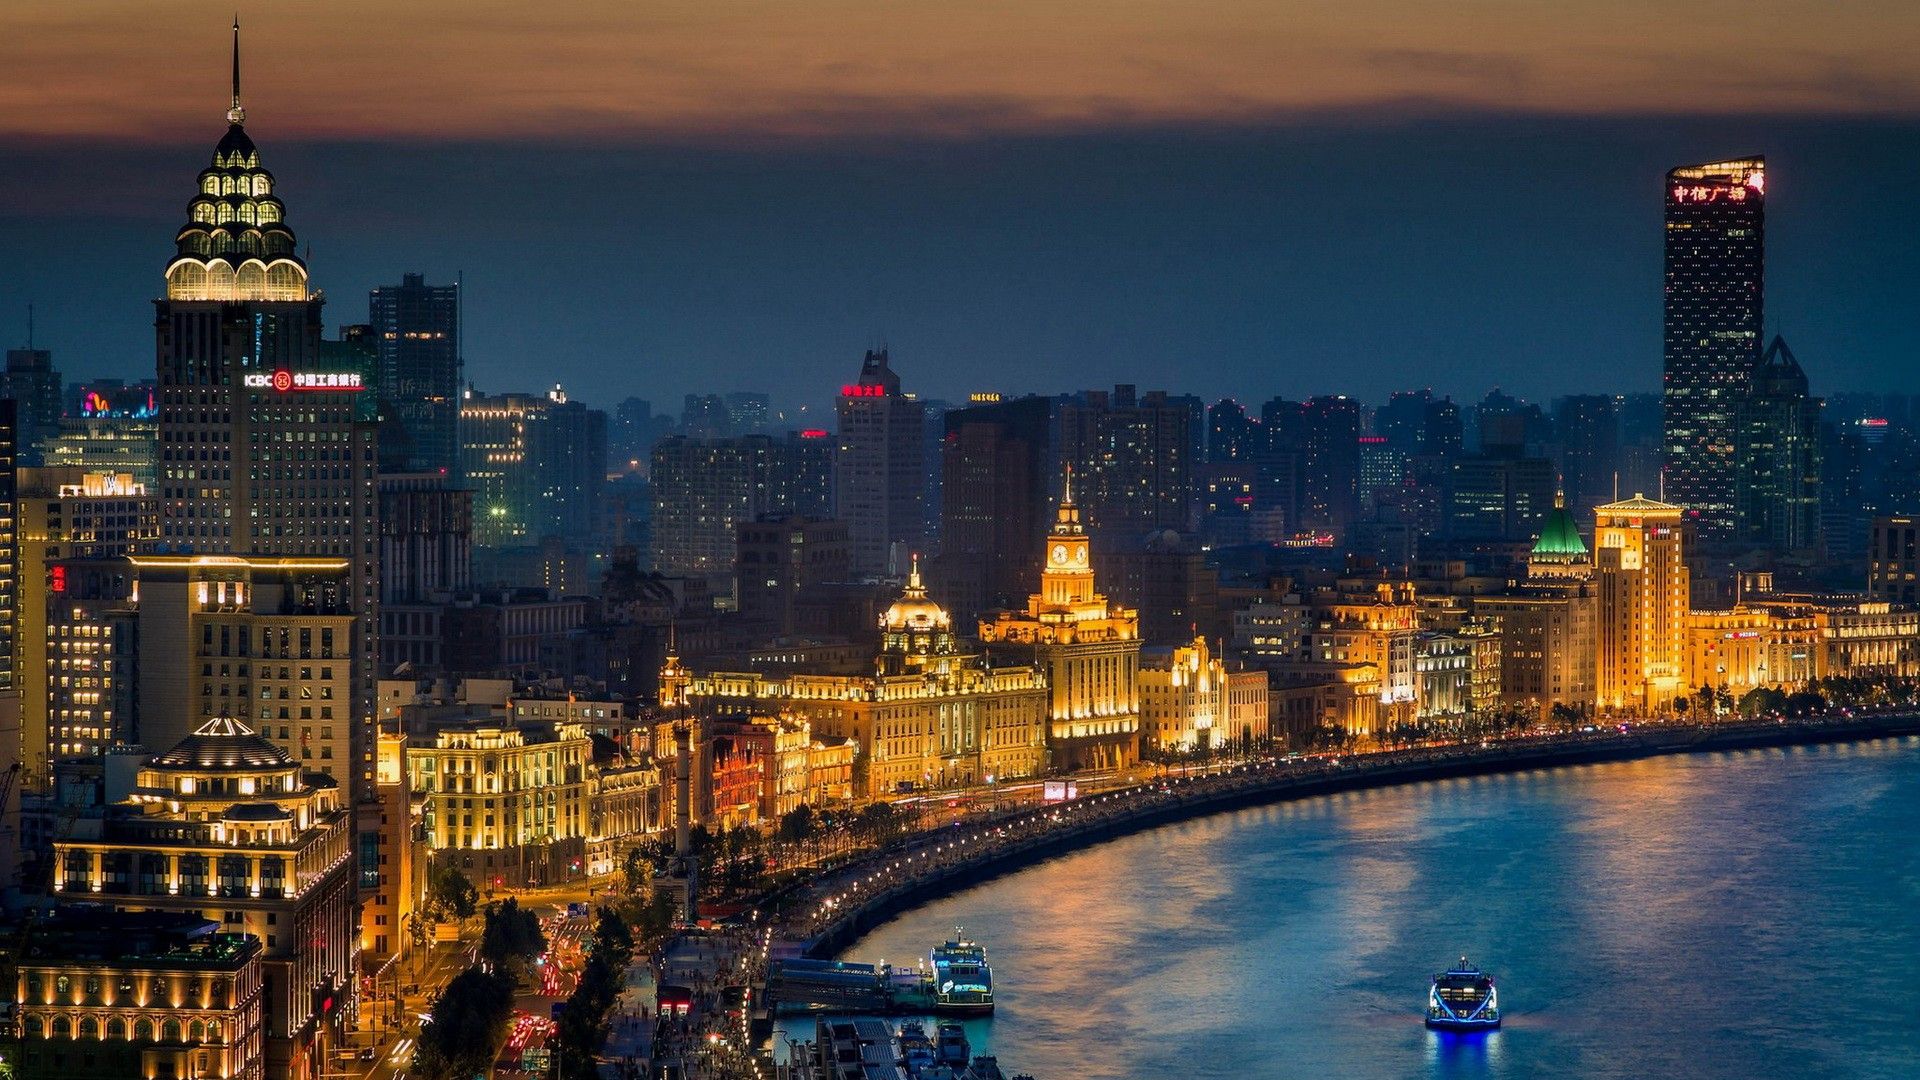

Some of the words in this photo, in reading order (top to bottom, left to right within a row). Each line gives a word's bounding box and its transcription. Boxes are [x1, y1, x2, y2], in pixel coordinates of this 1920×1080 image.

[1674, 185, 1746, 202] 中信广场
[244, 375, 273, 386] ICBC
